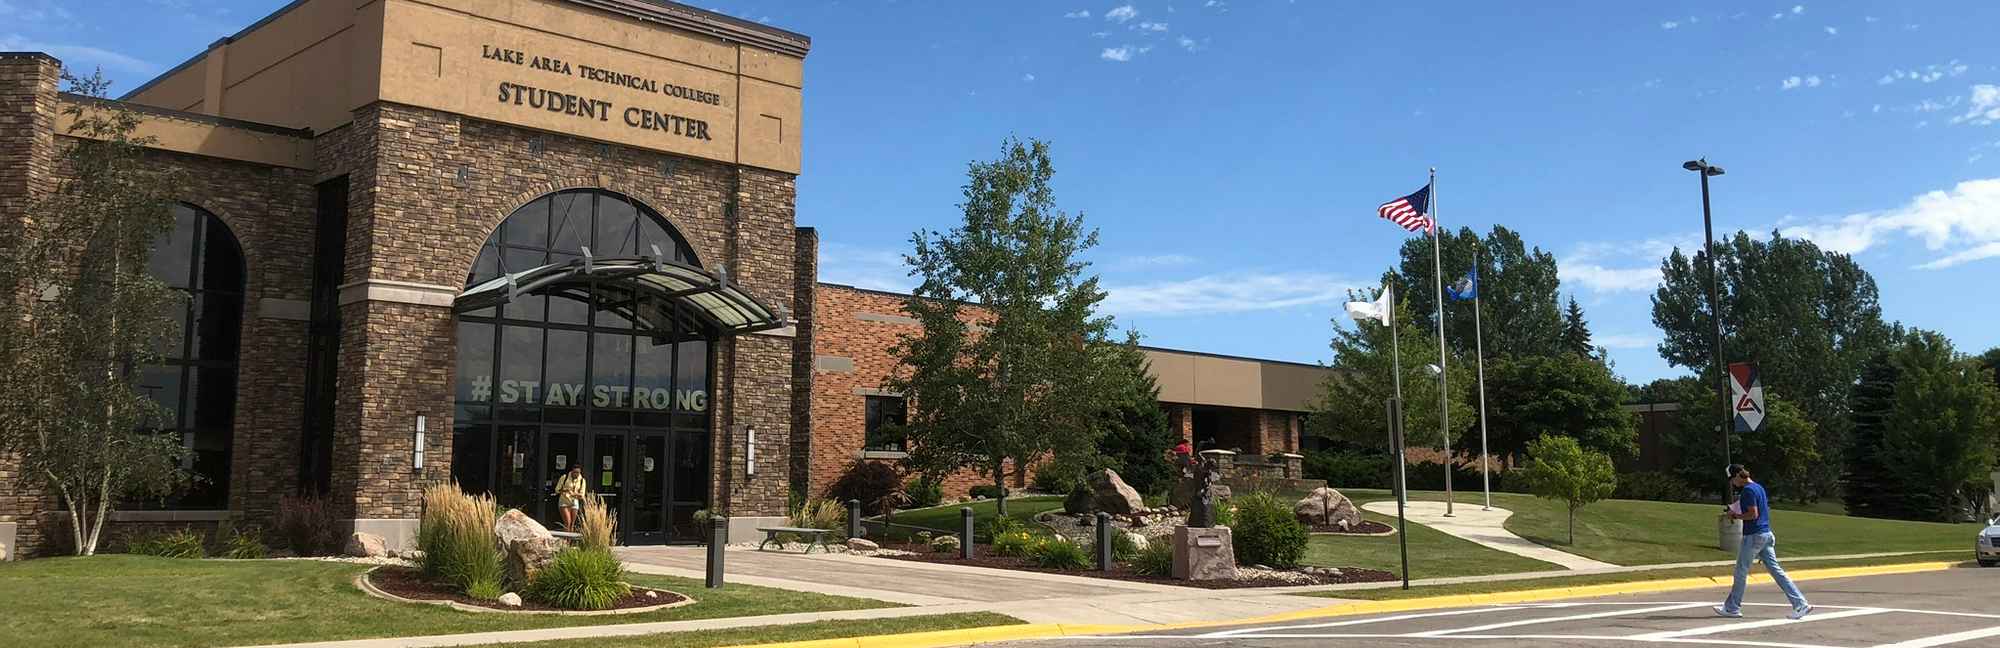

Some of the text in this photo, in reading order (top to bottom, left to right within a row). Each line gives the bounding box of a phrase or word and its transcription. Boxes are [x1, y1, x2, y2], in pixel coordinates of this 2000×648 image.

[482, 45, 720, 106] LAKE AREA TECHNICAL COLLEGE
[498, 81, 712, 141] STUDENT CENTER
[592, 385, 707, 412] STRONG
